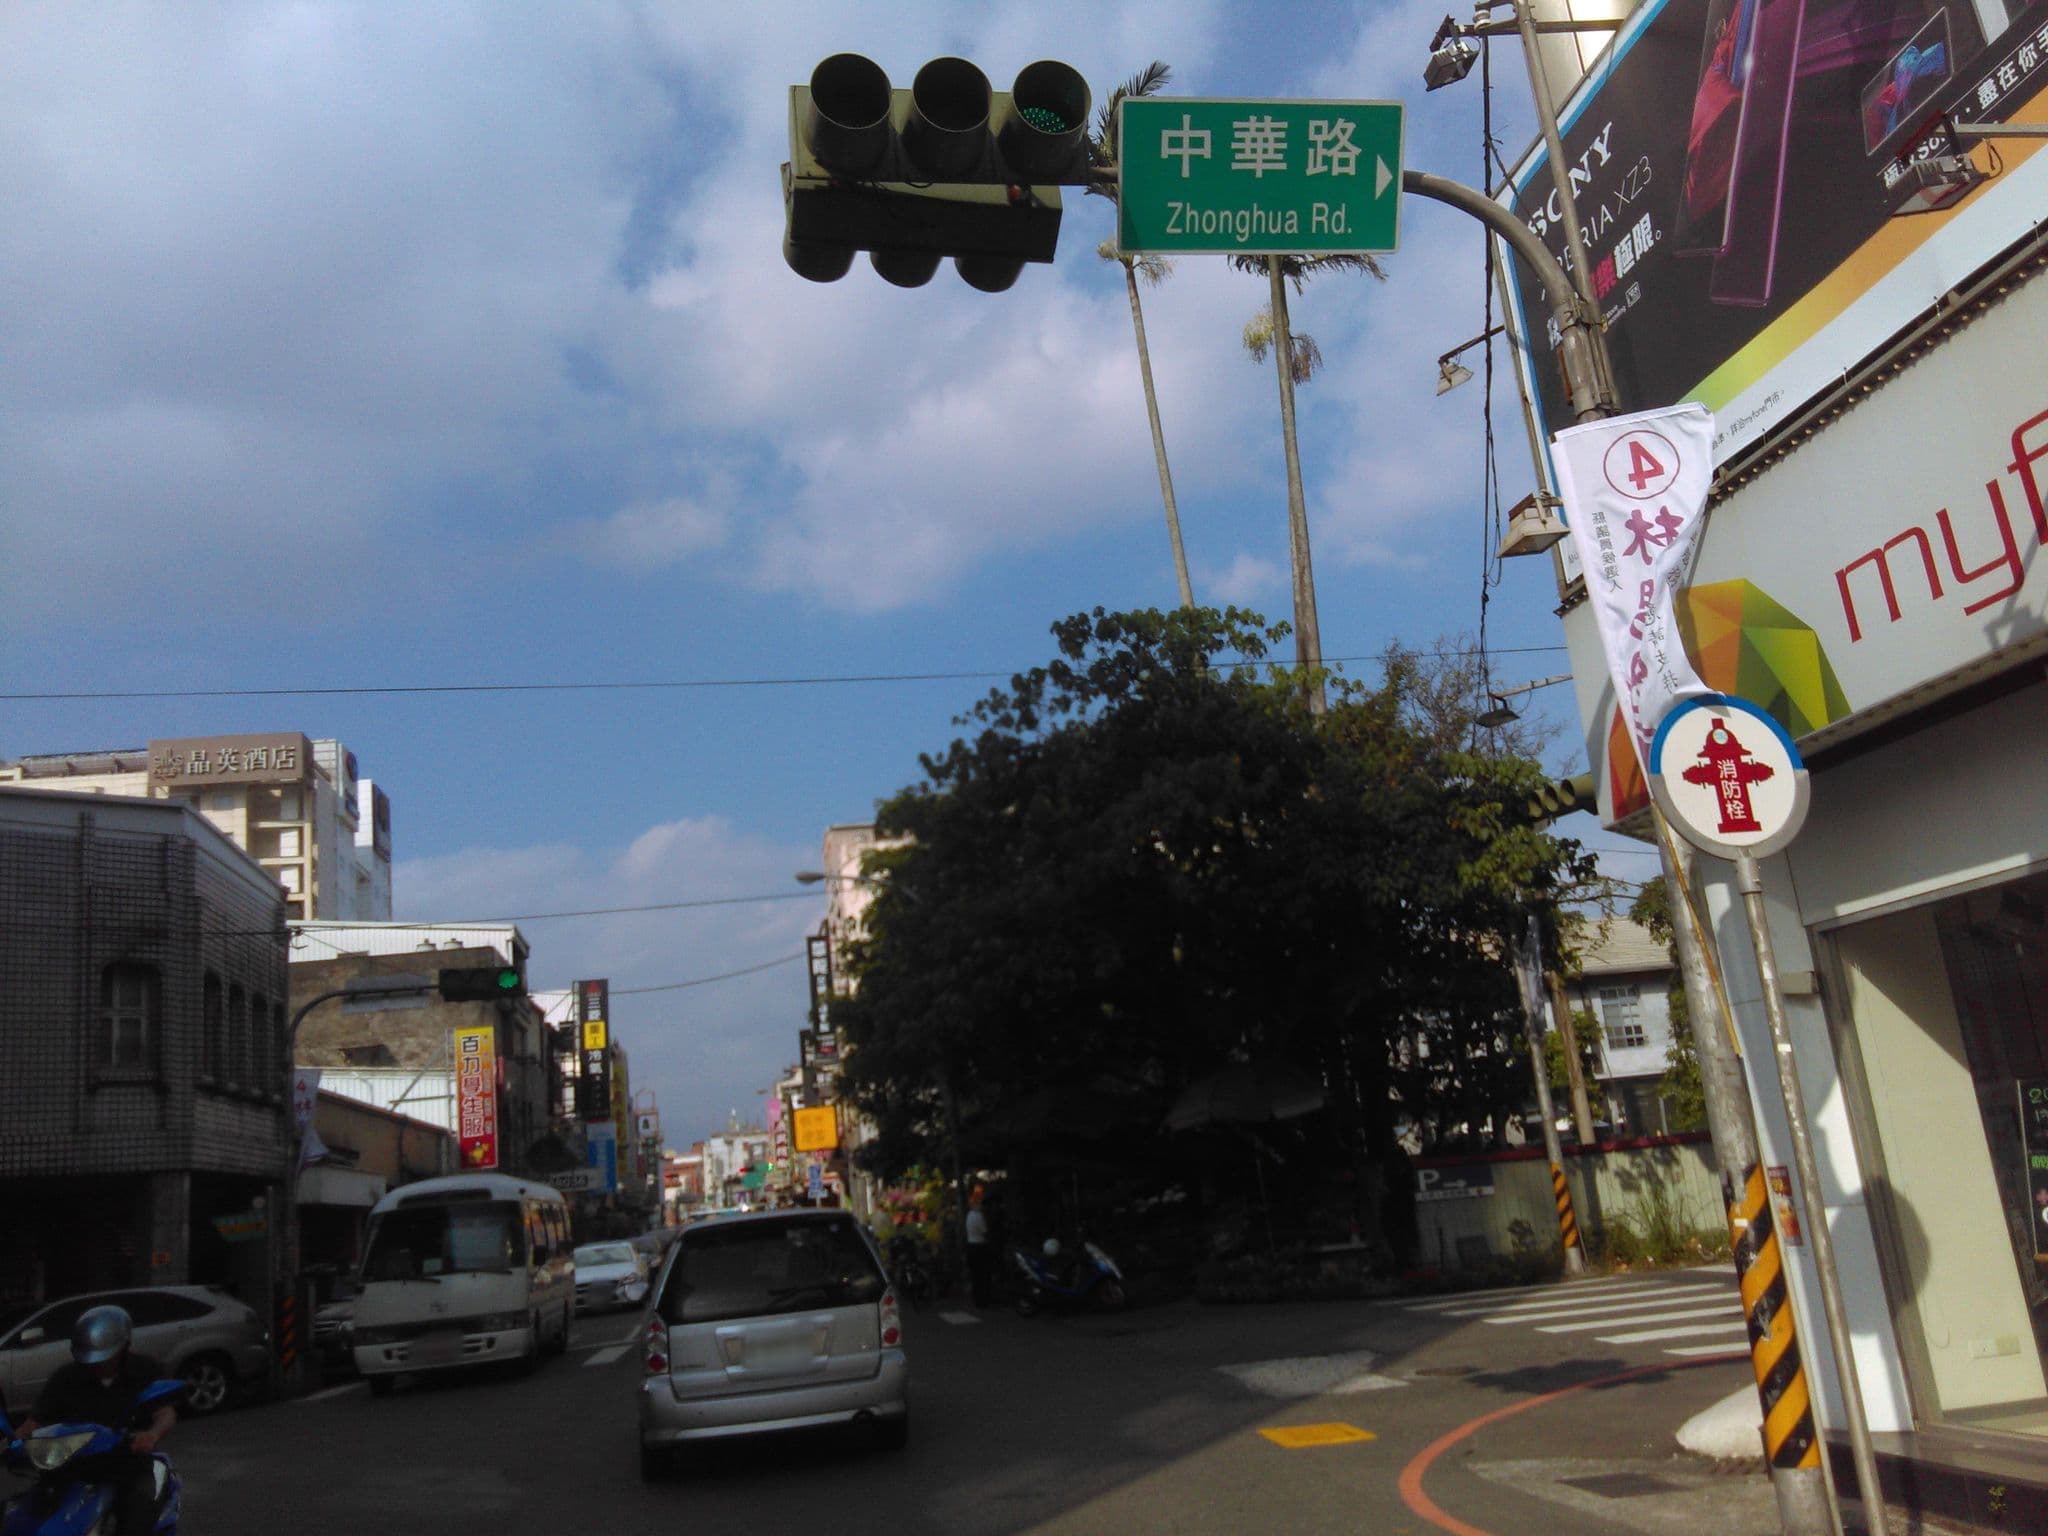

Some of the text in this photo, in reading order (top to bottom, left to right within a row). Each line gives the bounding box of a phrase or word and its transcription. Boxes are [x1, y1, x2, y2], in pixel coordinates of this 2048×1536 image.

[1160, 114, 1362, 178] 中華路
[1613, 155, 1653, 216] XZ3
[1166, 202, 1353, 242] Zhonghua Rd.
[186, 744, 297, 775] 晶英酒店
[1716, 759, 1747, 820] 消防栓
